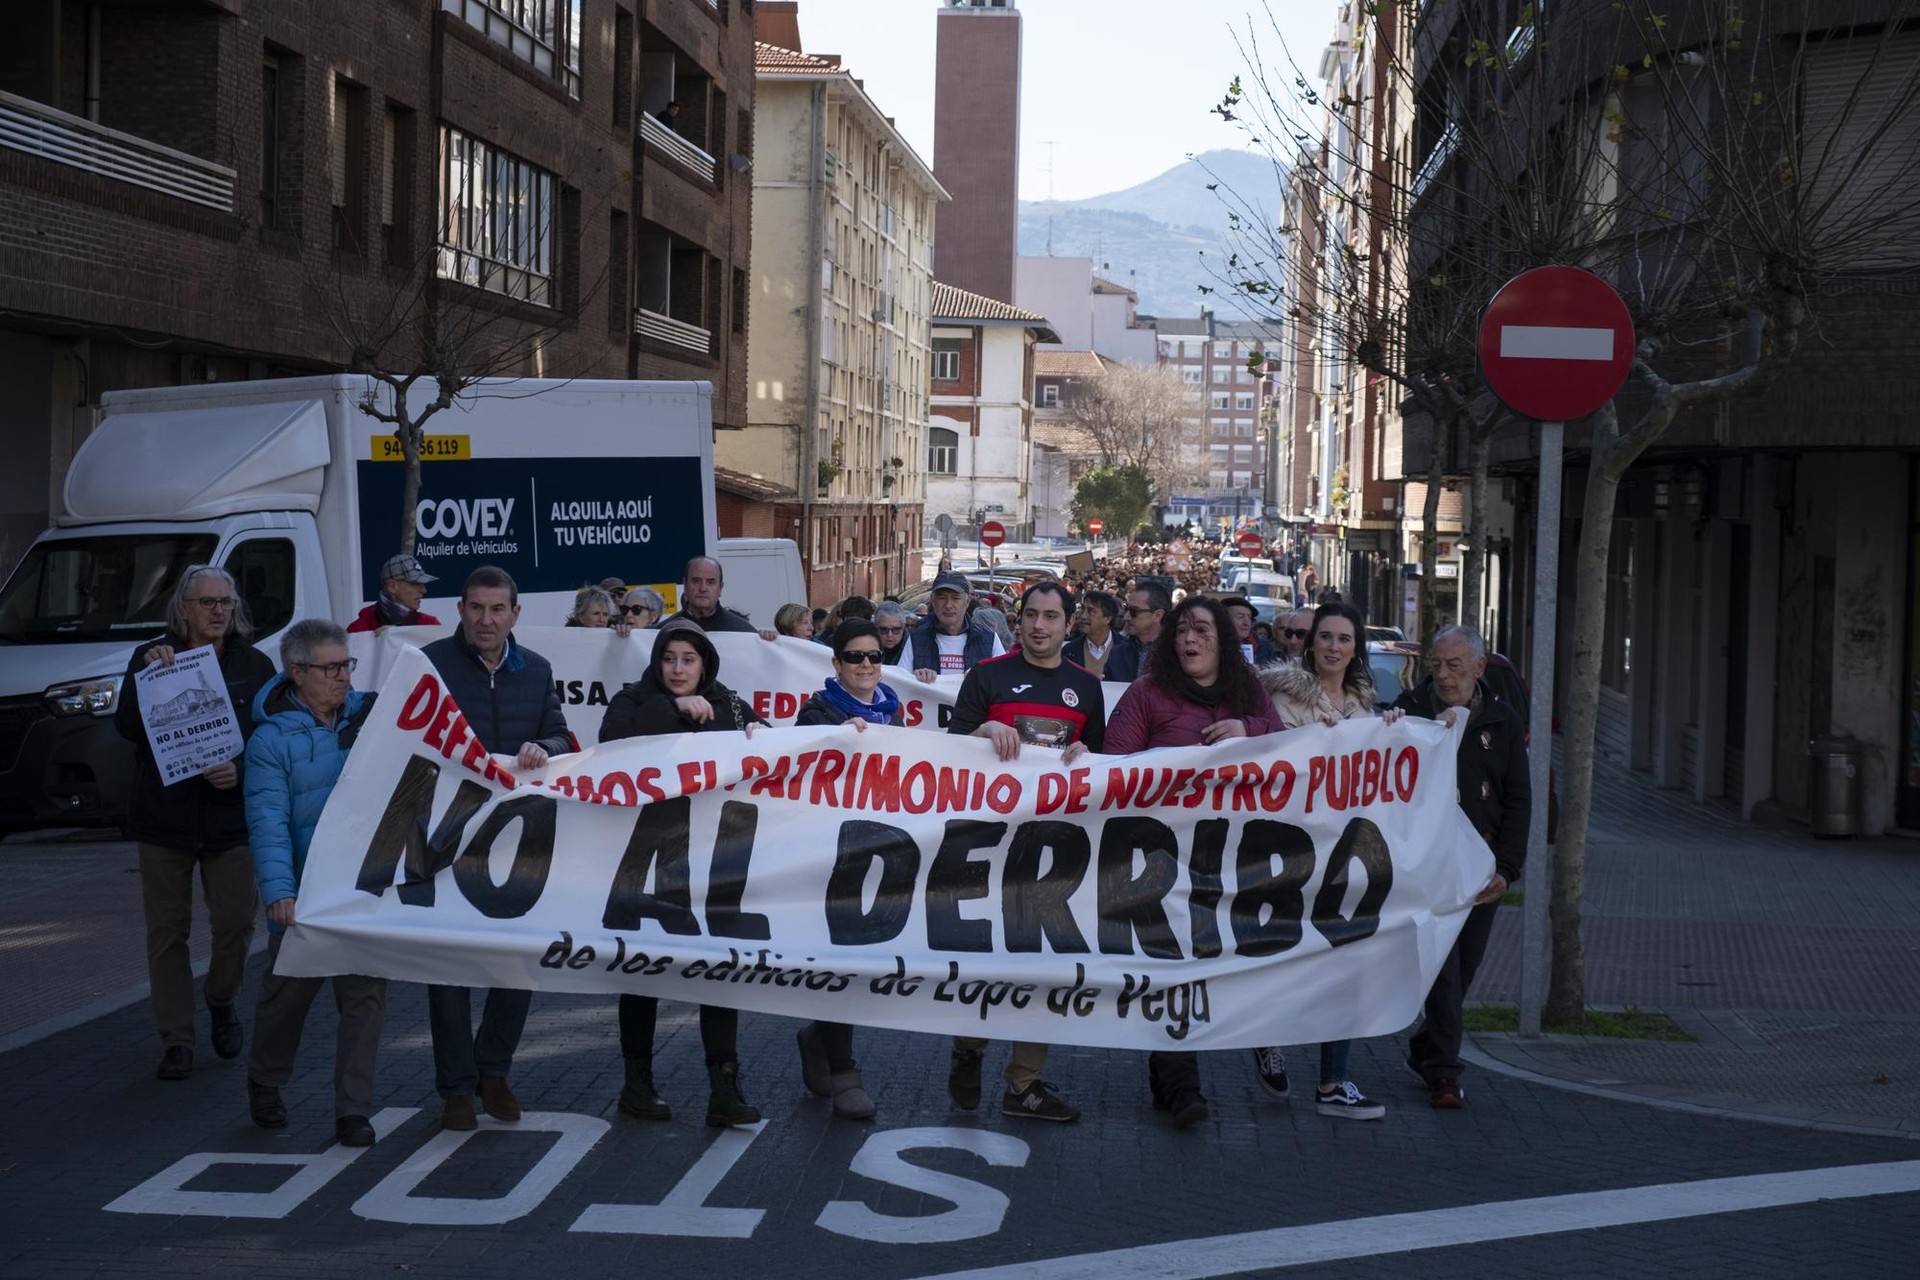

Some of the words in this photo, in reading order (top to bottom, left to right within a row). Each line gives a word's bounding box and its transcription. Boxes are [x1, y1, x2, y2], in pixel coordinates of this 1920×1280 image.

[437, 439, 458, 455] 119
[416, 497, 515, 539] COVEY
[550, 500, 614, 522] ALQUILA
[616, 495, 653, 520] AQUÍ
[553, 526, 575, 547] TU
[577, 521, 652, 545] VEHÍCULO
[416, 540, 454, 559] Alquiler
[456, 540, 470, 555] de
[471, 539, 519, 555] Vehículos
[155, 667, 179, 678] NUESTRO
[179, 661, 201, 672] PUEBLO
[156, 733, 171, 745] NO
[173, 728, 186, 740] AL
[187, 716, 230, 736] DERRIBO
[725, 748, 1023, 815] PATRIMONIO
[1035, 766, 1091, 816] DE
[1099, 760, 1297, 813] NUESTRO
[1304, 745, 1420, 814] PUEBLO
[355, 753, 557, 919] NO
[602, 795, 772, 940] AL
[825, 816, 1394, 960] DERRIBO
[539, 930, 597, 970] de
[606, 936, 674, 976] los
[681, 946, 859, 993] edificios
[869, 955, 925, 997] de
[933, 960, 1038, 1021] Lope
[1047, 962, 1102, 1018] de
[1115, 972, 1212, 1041] Vega
